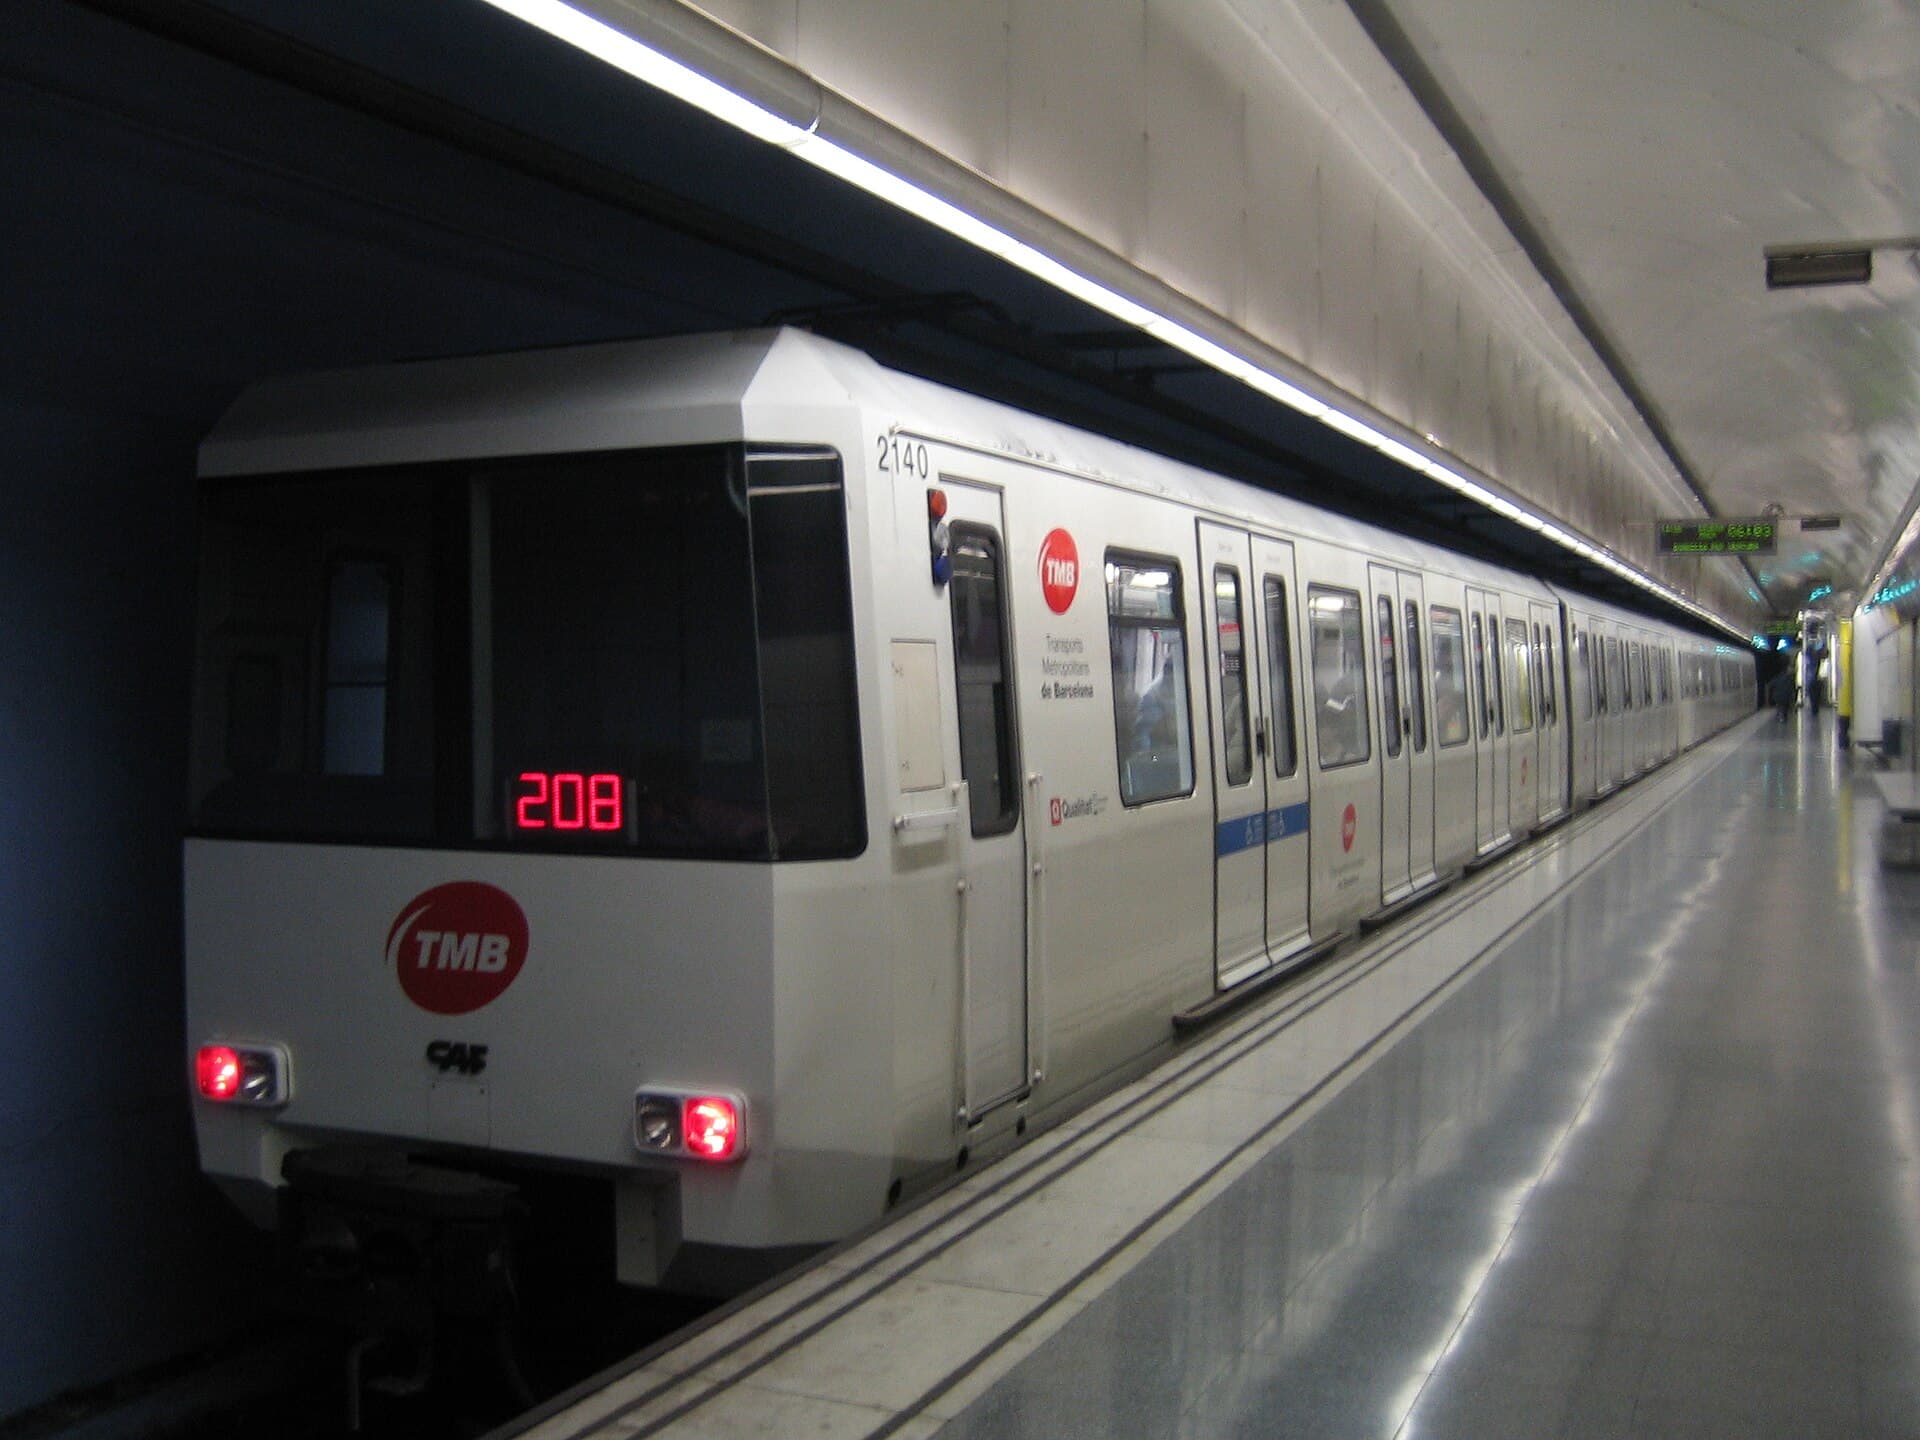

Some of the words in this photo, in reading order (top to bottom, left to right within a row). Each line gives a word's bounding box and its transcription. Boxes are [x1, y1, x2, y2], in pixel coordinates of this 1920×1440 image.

[876, 434, 929, 479] 2140
[1046, 558, 1075, 587] TMB
[1041, 681, 1052, 699] de
[1053, 681, 1094, 699] Barcelona
[516, 772, 622, 831] 208
[415, 930, 511, 974] TMB
